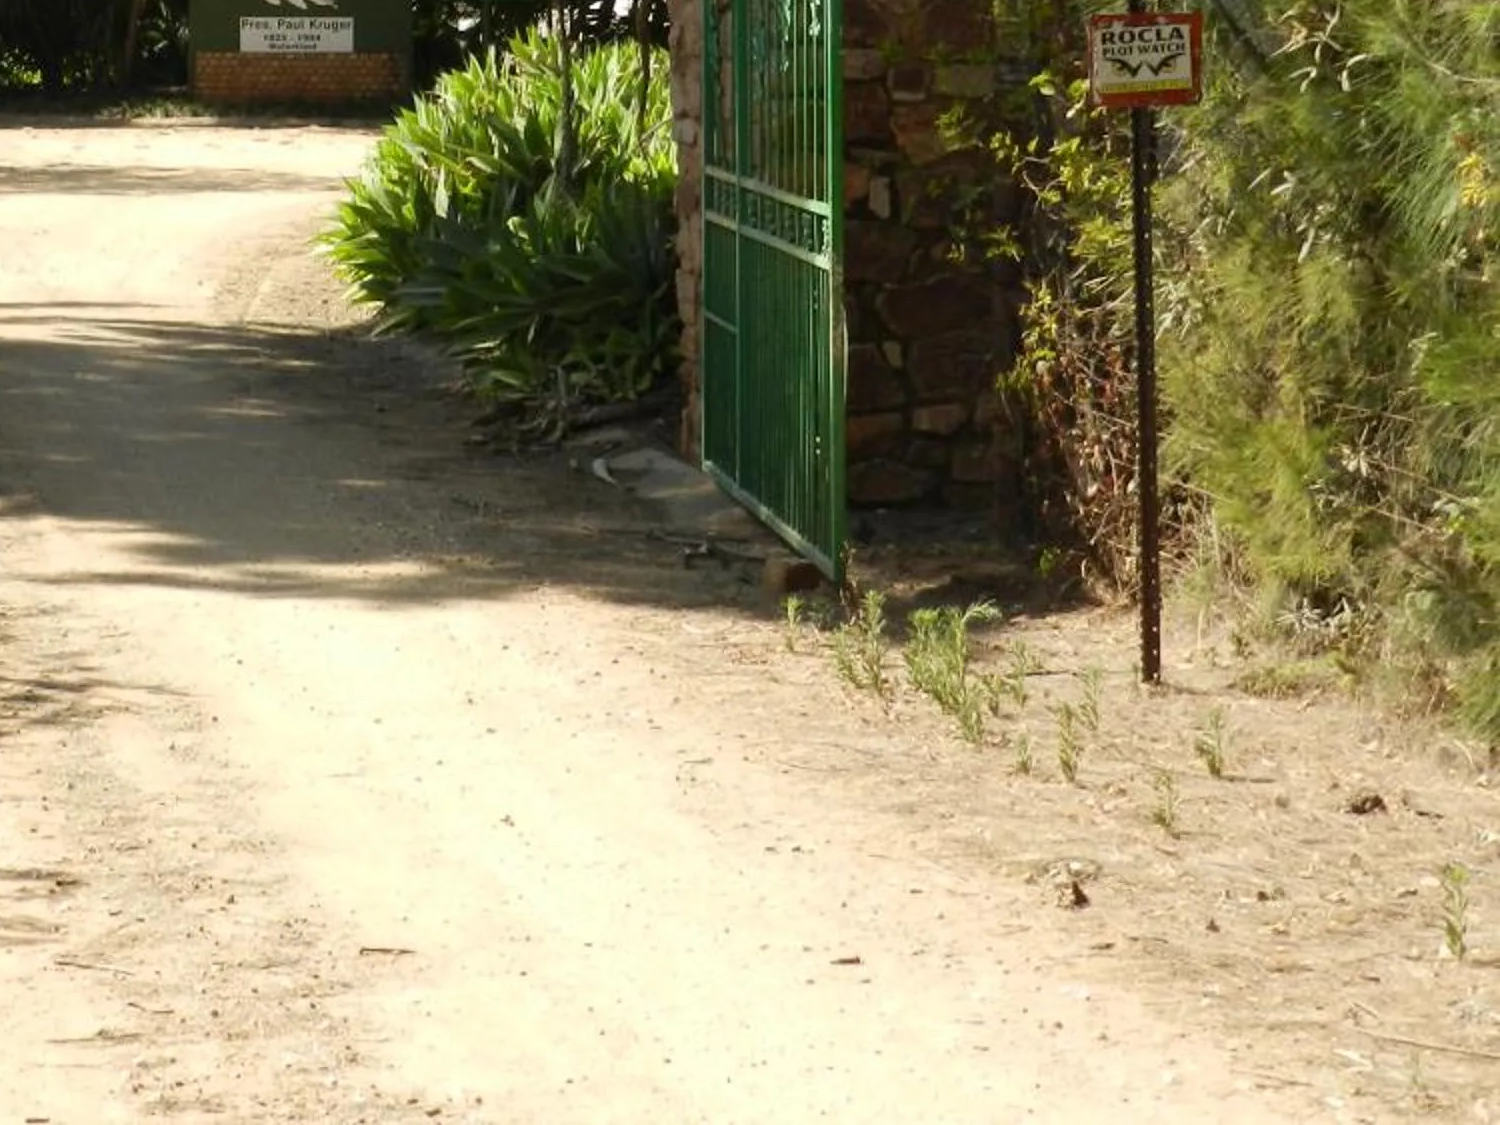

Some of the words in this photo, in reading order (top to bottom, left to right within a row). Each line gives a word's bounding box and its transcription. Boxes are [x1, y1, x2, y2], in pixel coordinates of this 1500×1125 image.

[277, 18, 306, 30] Paul
[309, 18, 351, 33] Kruger
[1101, 26, 1185, 45] ROCLA
[1102, 46, 1134, 57] PLOT
[1137, 42, 1186, 55] WATCH
